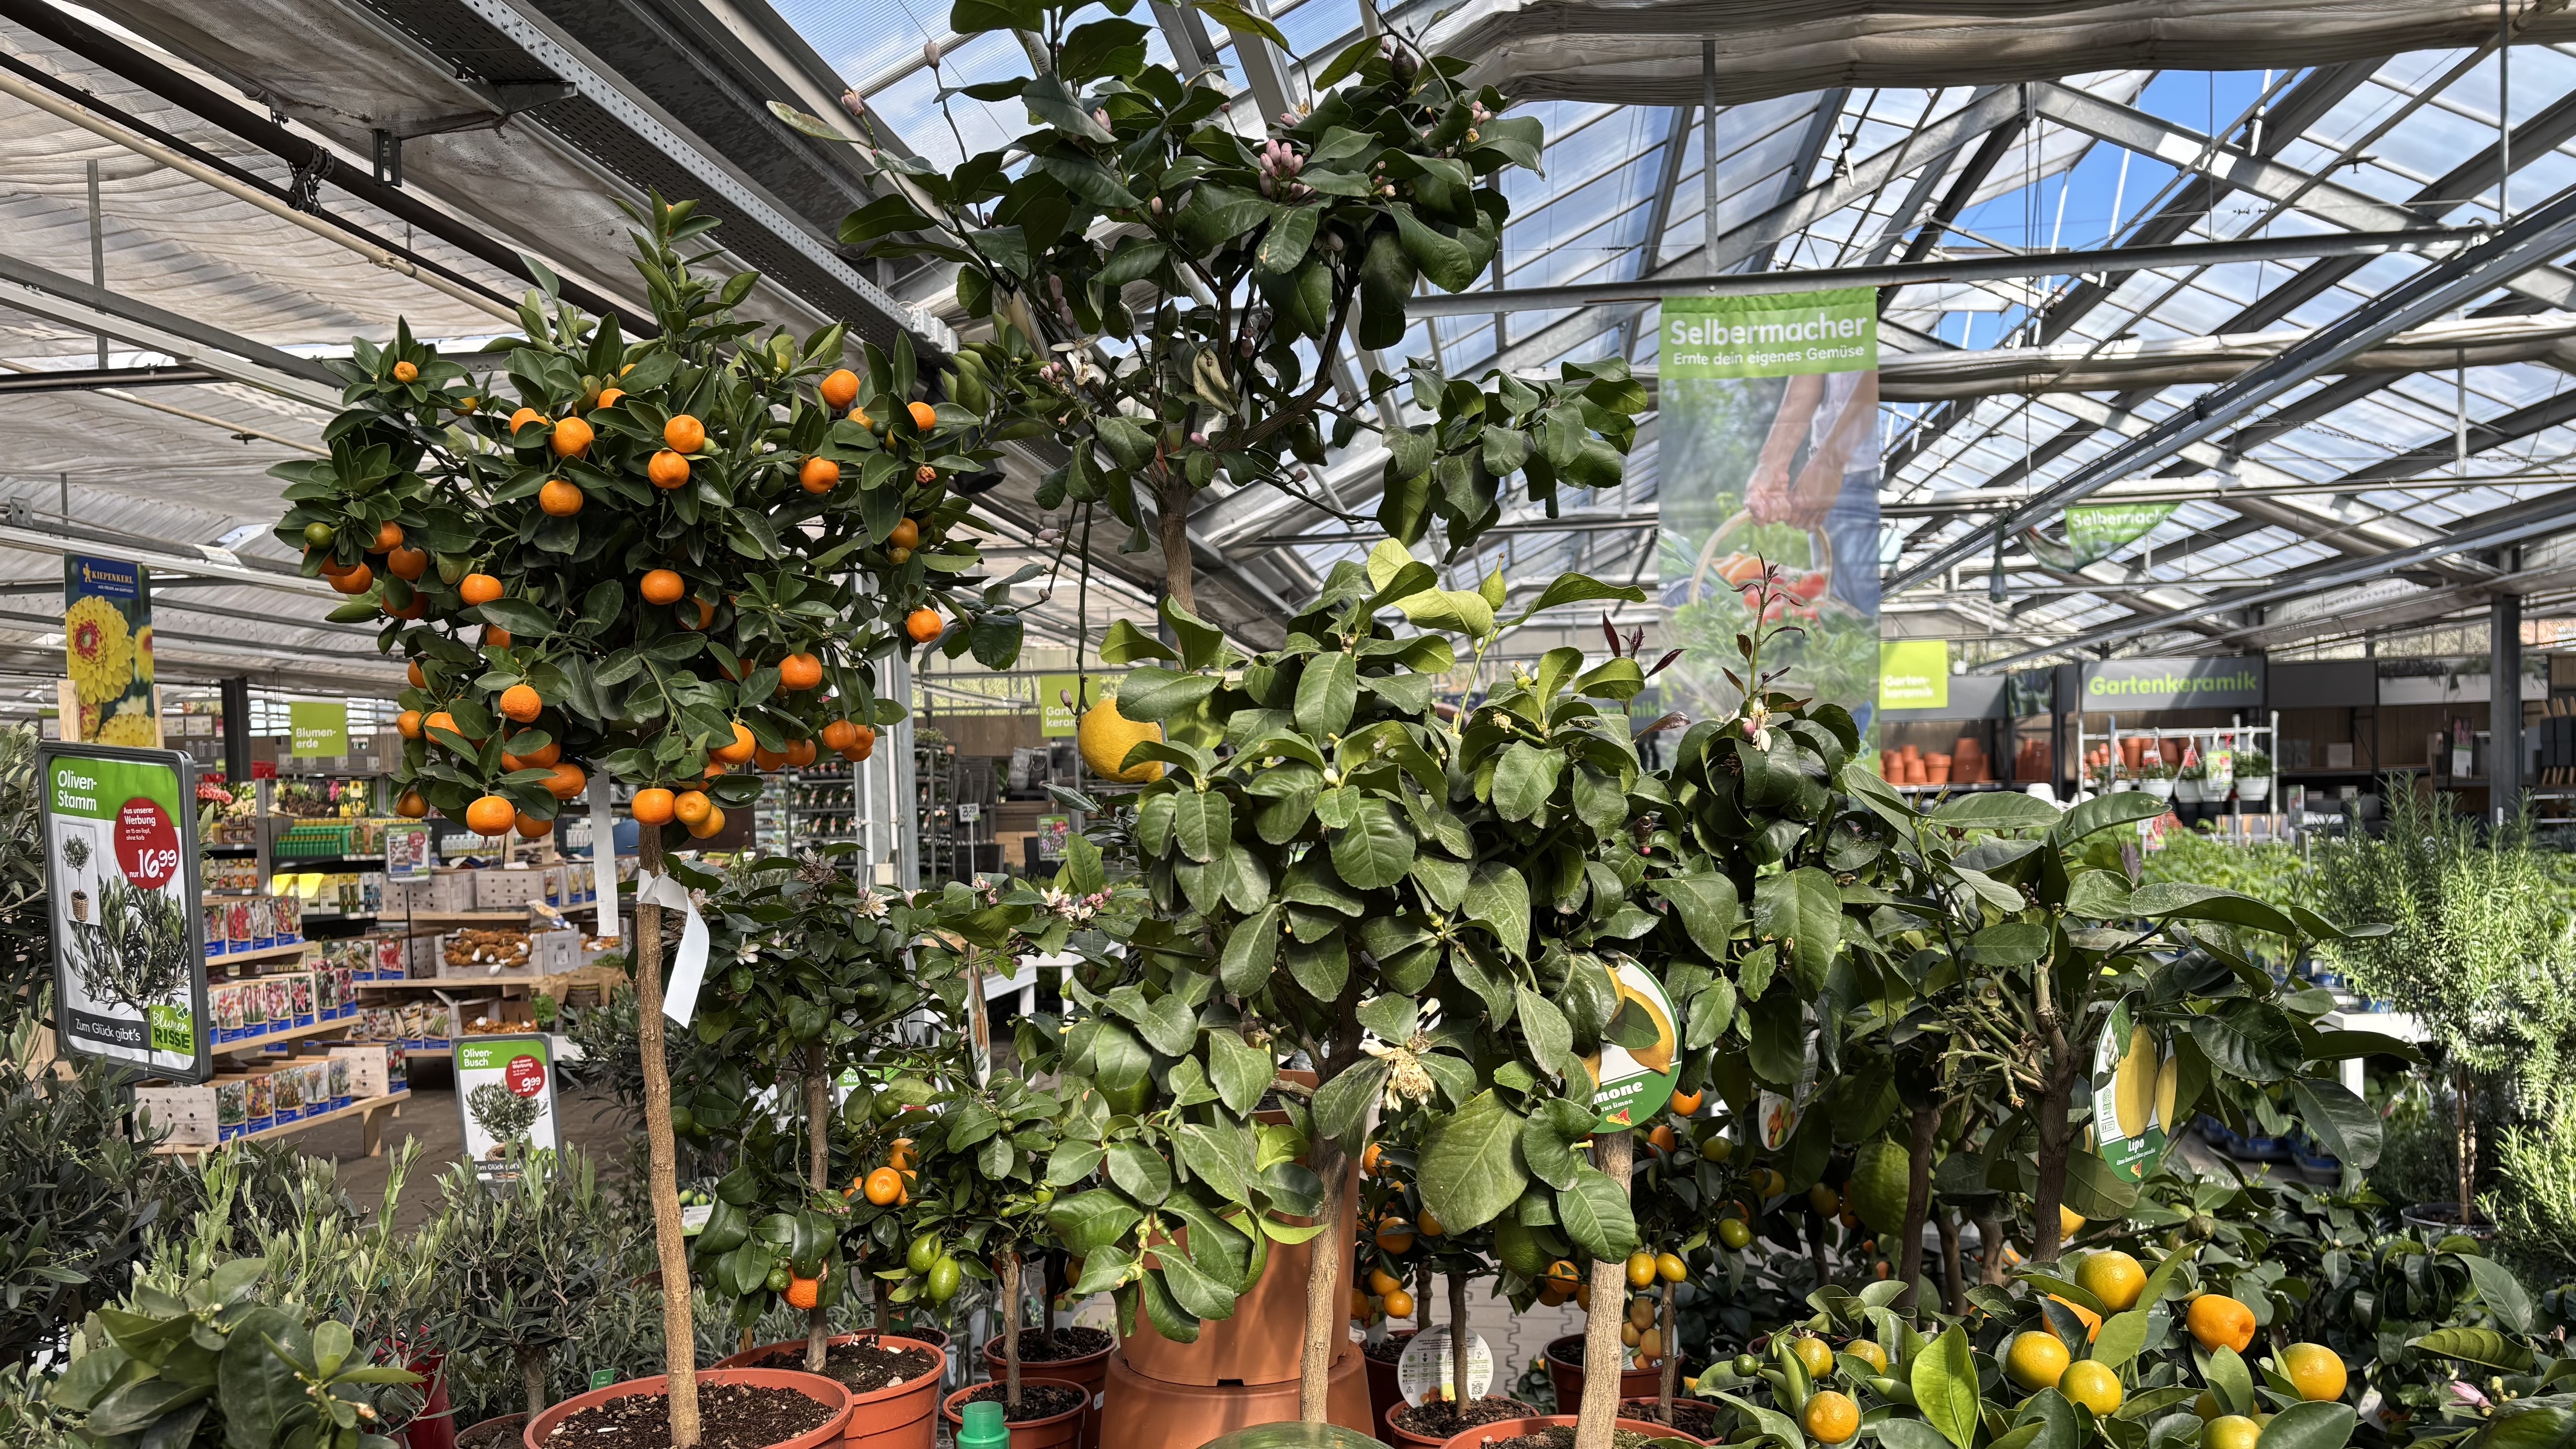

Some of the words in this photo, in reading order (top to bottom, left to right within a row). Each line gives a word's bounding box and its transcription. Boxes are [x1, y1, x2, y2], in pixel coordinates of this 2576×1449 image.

[1670, 312, 1868, 345] Selbermacher
[1673, 352, 1709, 365] Ernte
[1713, 352, 1743, 365] dein
[1747, 350, 1802, 367] eigenes
[1806, 345, 1865, 361] Gemüse
[92, 570, 134, 584] KIEPENKERL
[2088, 670, 2257, 695] Gartenkeramik
[296, 727, 336, 737] Blumen-
[296, 738, 318, 749] erde
[58, 770, 97, 791] Oliven-
[58, 790, 97, 811] Stamm
[124, 814, 156, 827] Werbung
[75, 1018, 90, 1032] Zum
[92, 1022, 114, 1037] Glück
[115, 1028, 141, 1042] gibt's
[152, 1010, 190, 1032] Blumen
[154, 1028, 190, 1049] RISSE
[463, 1048, 492, 1058] Oliven-
[464, 1058, 488, 1067] Busch
[1612, 1099, 1633, 1109] limon
[2128, 1138, 2144, 1154] Lipo
